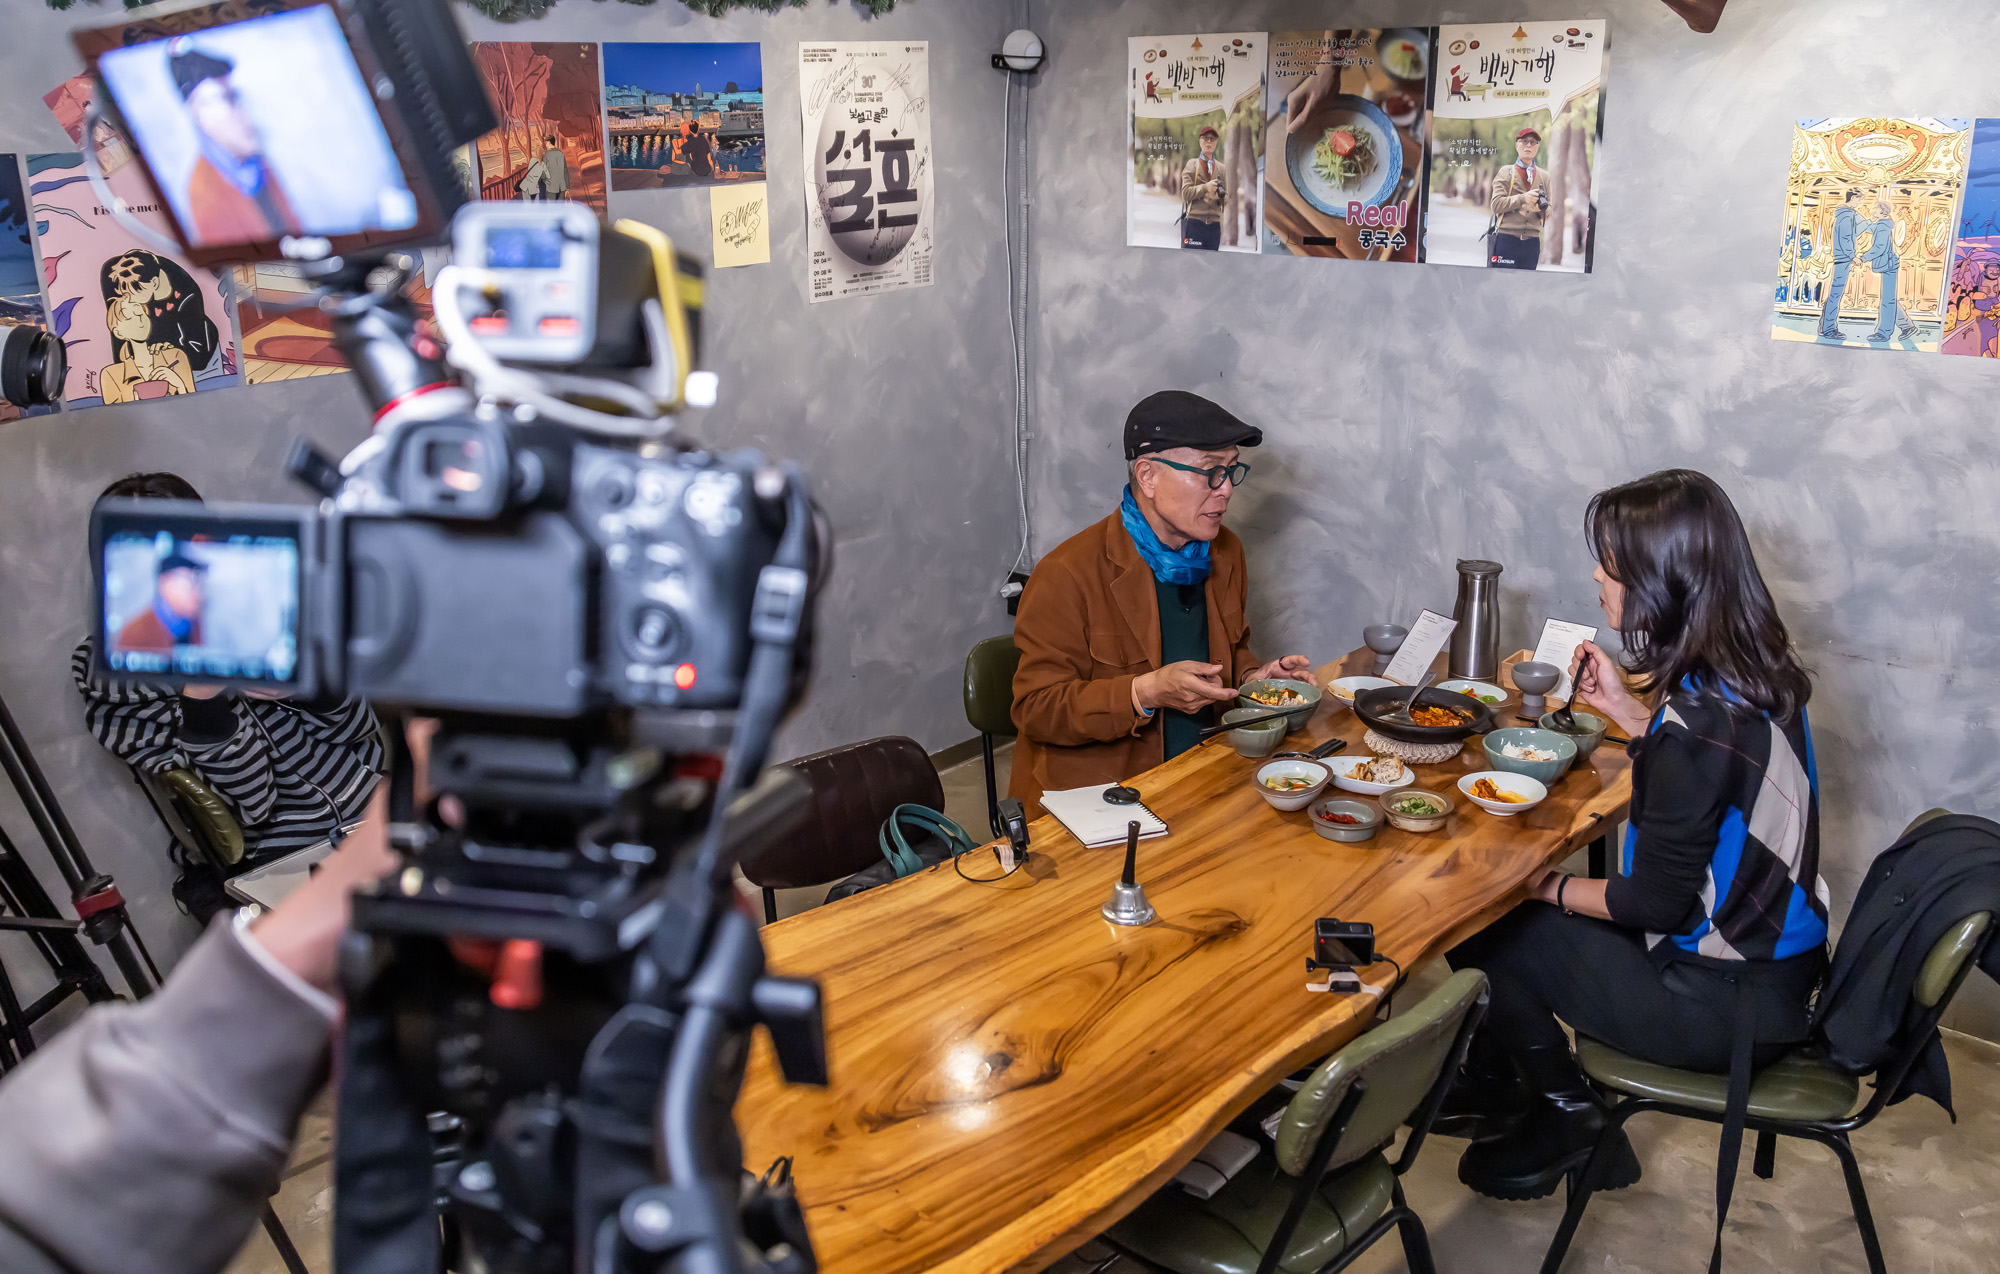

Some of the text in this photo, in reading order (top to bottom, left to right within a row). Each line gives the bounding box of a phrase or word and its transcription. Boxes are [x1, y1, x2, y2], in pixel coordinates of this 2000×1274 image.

[1168, 55, 1224, 90] 백반기행
[1480, 46, 1555, 87] 백반기행
[849, 107, 872, 123] 낯설고
[1346, 200, 1407, 227] Real
[1358, 229, 1407, 250] 콩국수
